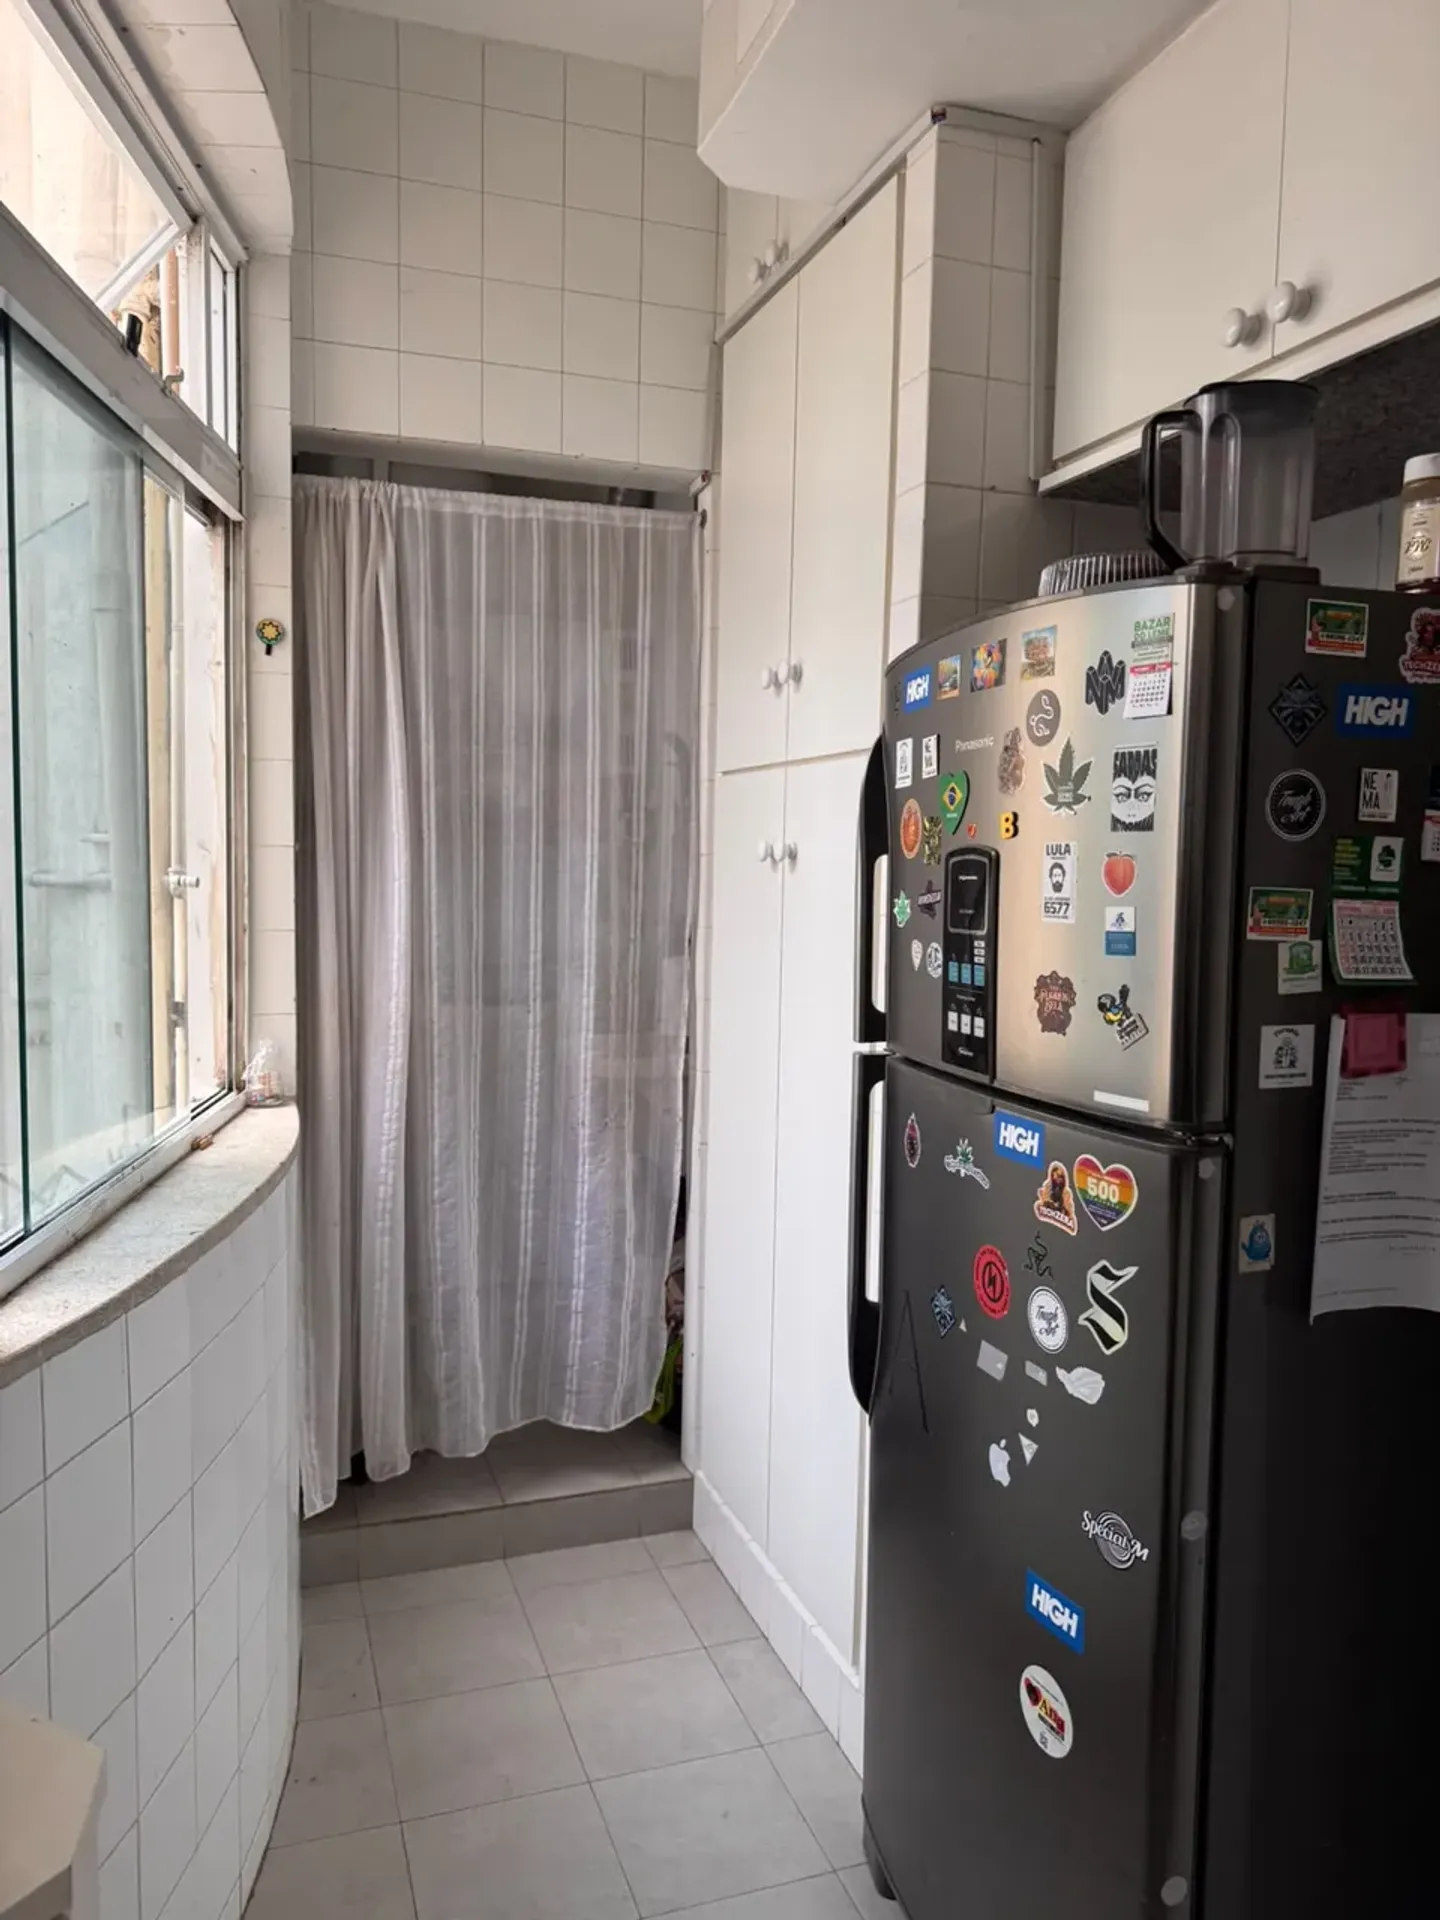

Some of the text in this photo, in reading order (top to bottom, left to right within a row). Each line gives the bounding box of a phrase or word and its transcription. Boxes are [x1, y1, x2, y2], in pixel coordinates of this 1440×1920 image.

[1134, 616, 1171, 632] BAZAR
[906, 673, 930, 704] HIGH
[1344, 695, 1409, 727] HIGH
[955, 736, 995, 753] Panasonic
[1363, 771, 1378, 790] NE
[1362, 791, 1380, 809] MA
[1000, 811, 1018, 840] B
[1046, 843, 1071, 856] LULA
[1044, 901, 1070, 914] 6577
[999, 1122, 1039, 1157] HIGH
[1087, 1176, 1120, 1204] 500
[1082, 1510, 1149, 1561] Special M
[1031, 1584, 1079, 1638] HIGH
